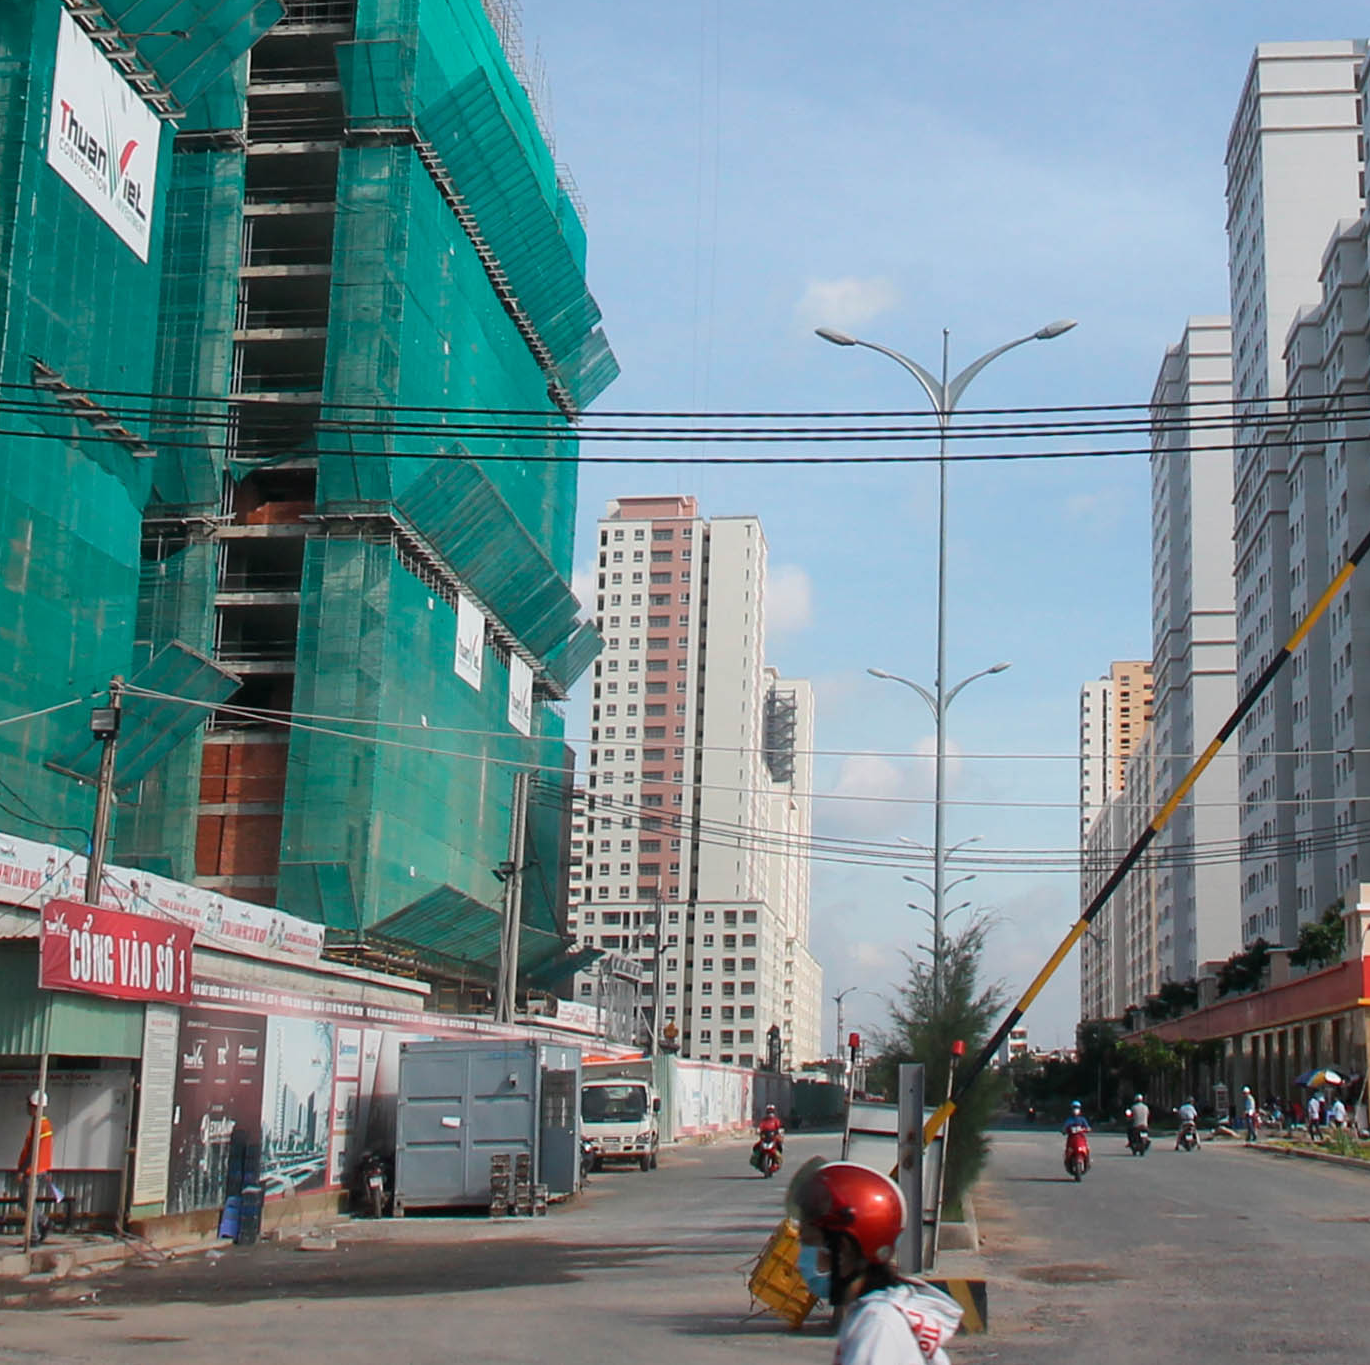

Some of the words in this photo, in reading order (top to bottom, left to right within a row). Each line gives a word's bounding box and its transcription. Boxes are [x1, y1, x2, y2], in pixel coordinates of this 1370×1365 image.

[69, 914, 114, 984] CỔNG
[119, 930, 151, 989] VÀO
[156, 933, 175, 992] SỐ
[179, 949, 185, 994] 1
